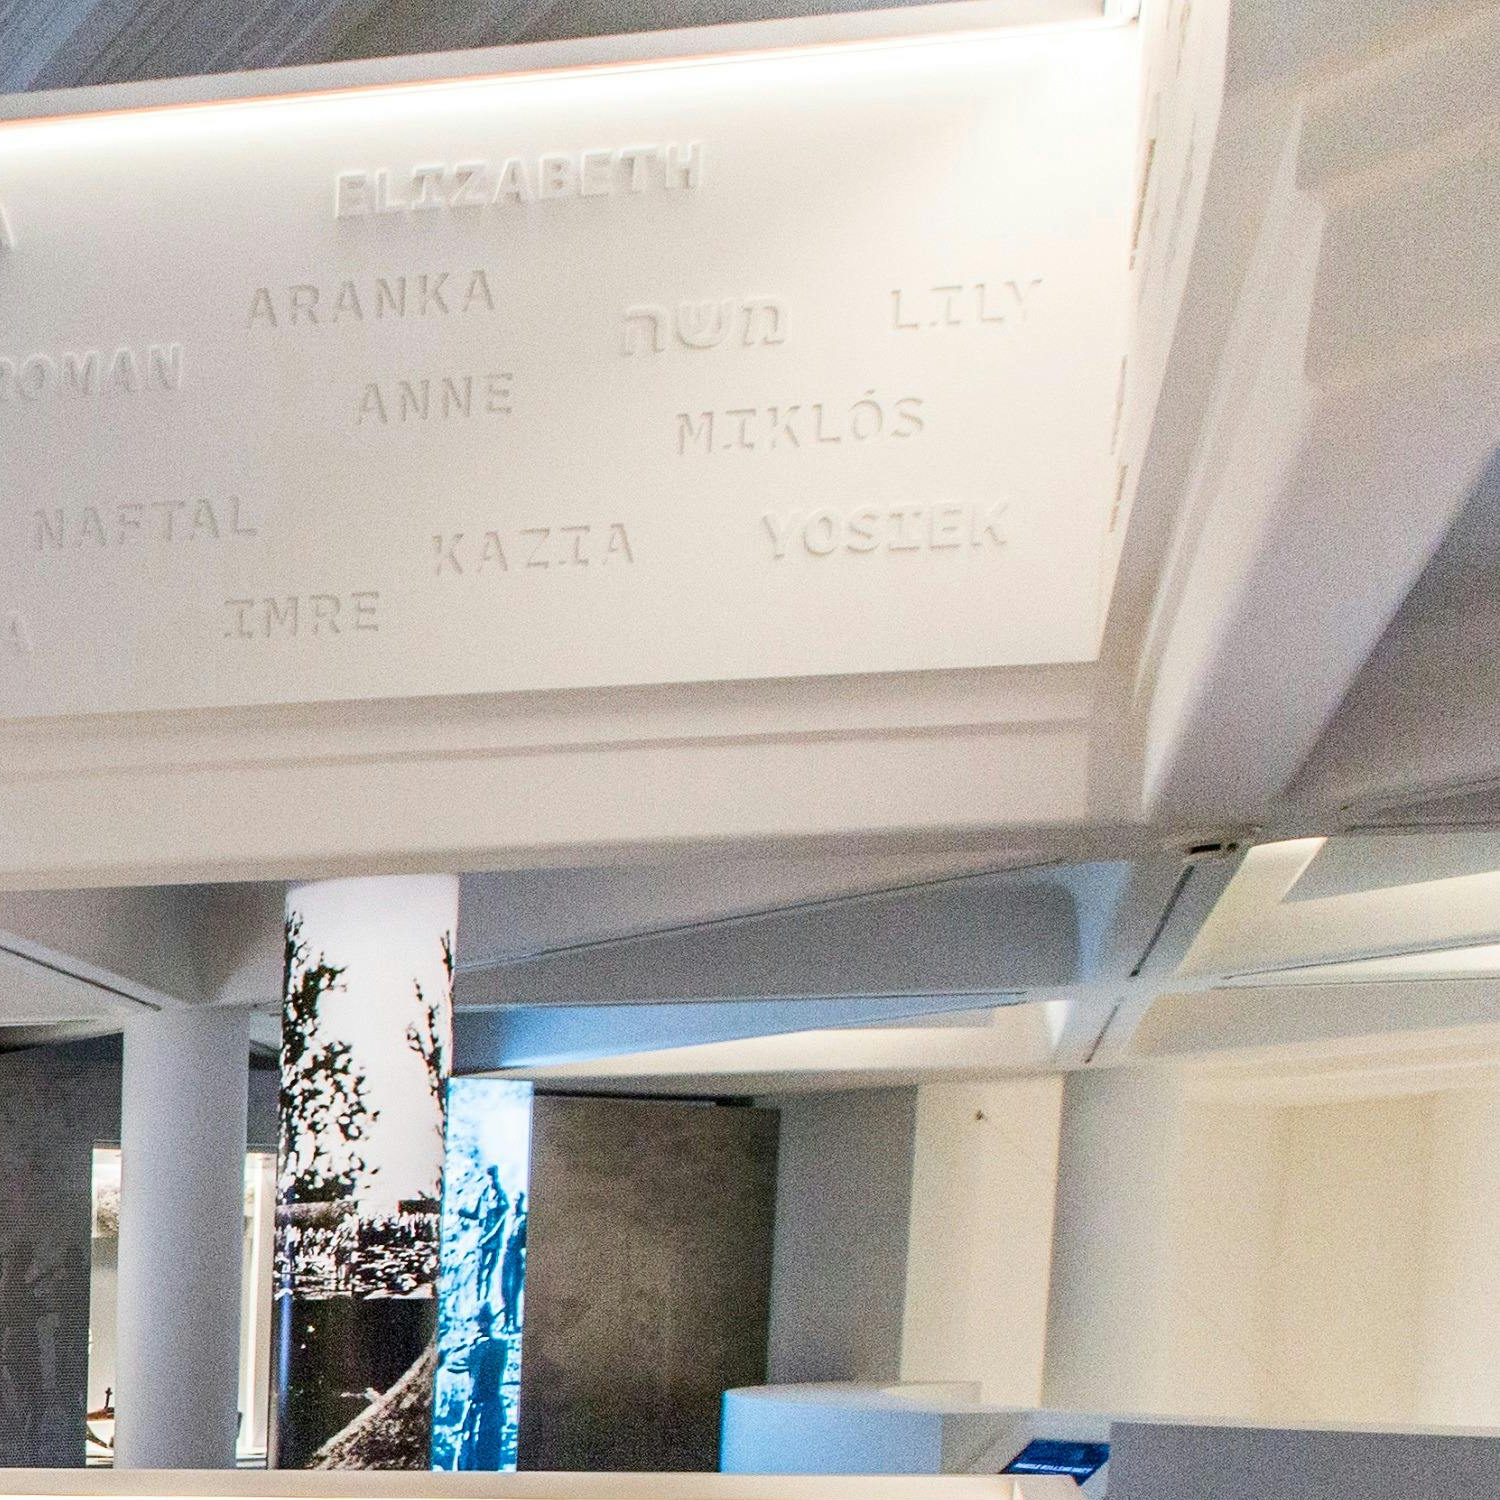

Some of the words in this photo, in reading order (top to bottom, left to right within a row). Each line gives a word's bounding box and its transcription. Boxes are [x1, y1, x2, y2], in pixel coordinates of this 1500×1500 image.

[334, 142, 706, 221] ELIZABETH
[246, 268, 497, 330] ARANKA
[618, 292, 788, 360] משה
[890, 276, 1045, 332] LILY
[355, 372, 516, 426] ANNE
[676, 388, 928, 458] MIKLÓS
[32, 494, 260, 553] NAFTAL
[432, 521, 637, 576] KAZIA
[760, 498, 1011, 562] YOSIEK
[222, 591, 383, 641] IMRE
